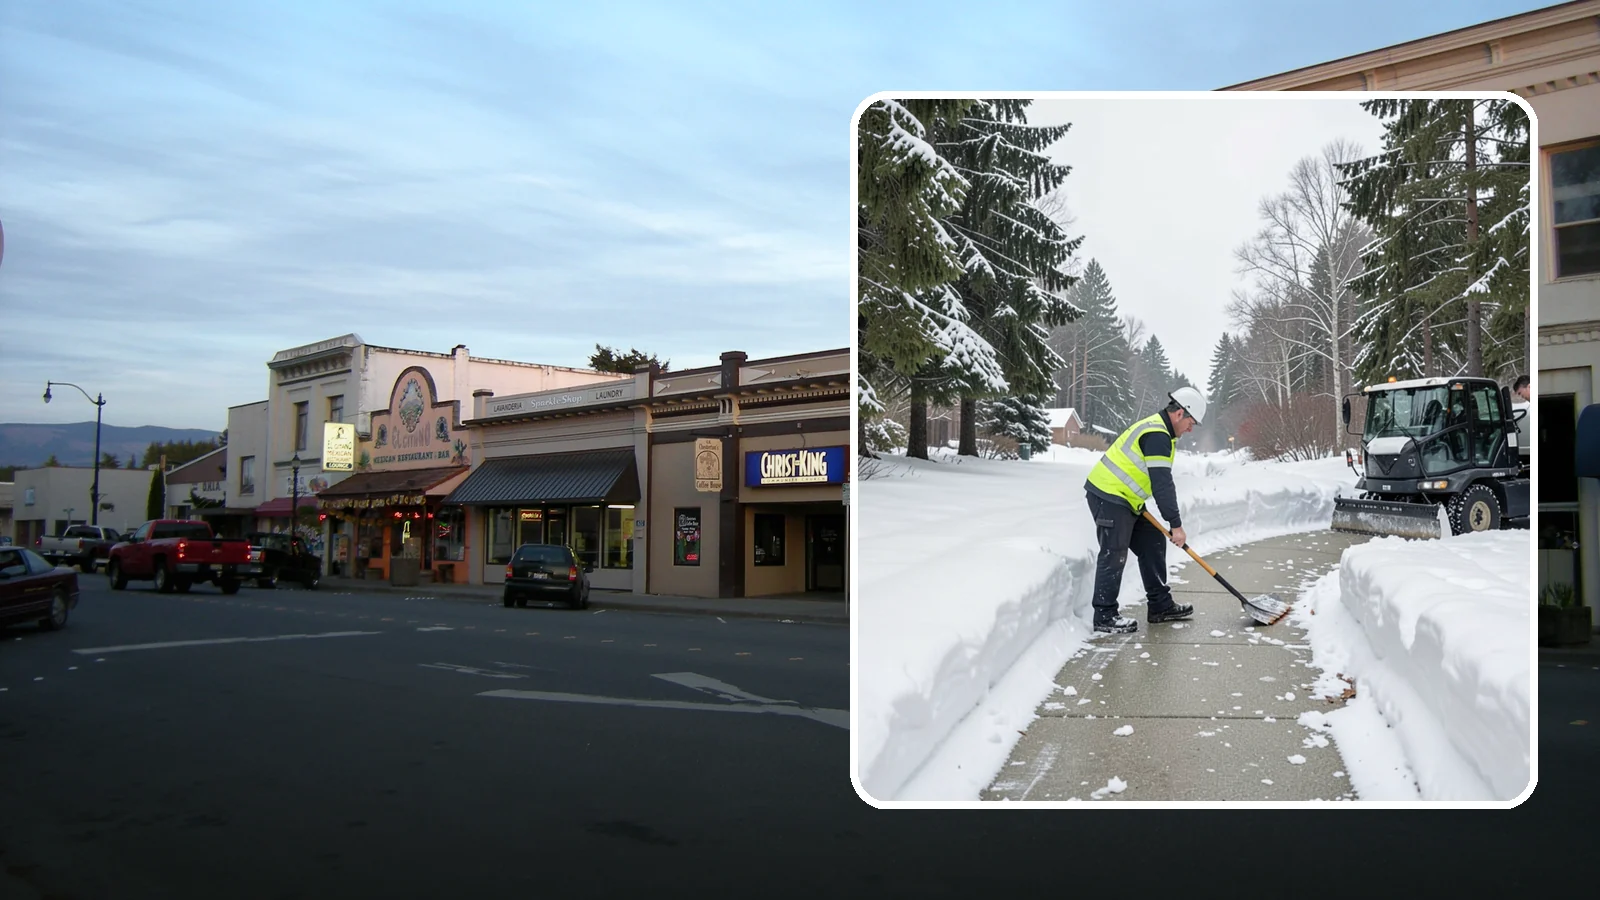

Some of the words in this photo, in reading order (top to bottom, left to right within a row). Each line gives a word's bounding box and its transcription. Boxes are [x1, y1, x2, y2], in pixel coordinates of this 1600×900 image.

[595, 389, 624, 400] LAUNDRY
[493, 402, 523, 413] LAVANDERIA
[531, 396, 561, 409] Sparkle
[562, 394, 582, 405] Shop
[373, 454, 396, 464] MEXICAN
[397, 451, 434, 462] RESTAURANT
[437, 450, 450, 459] BAR
[799, 450, 828, 476] KING
[697, 480, 709, 489] Coffee
[710, 480, 721, 489] House
